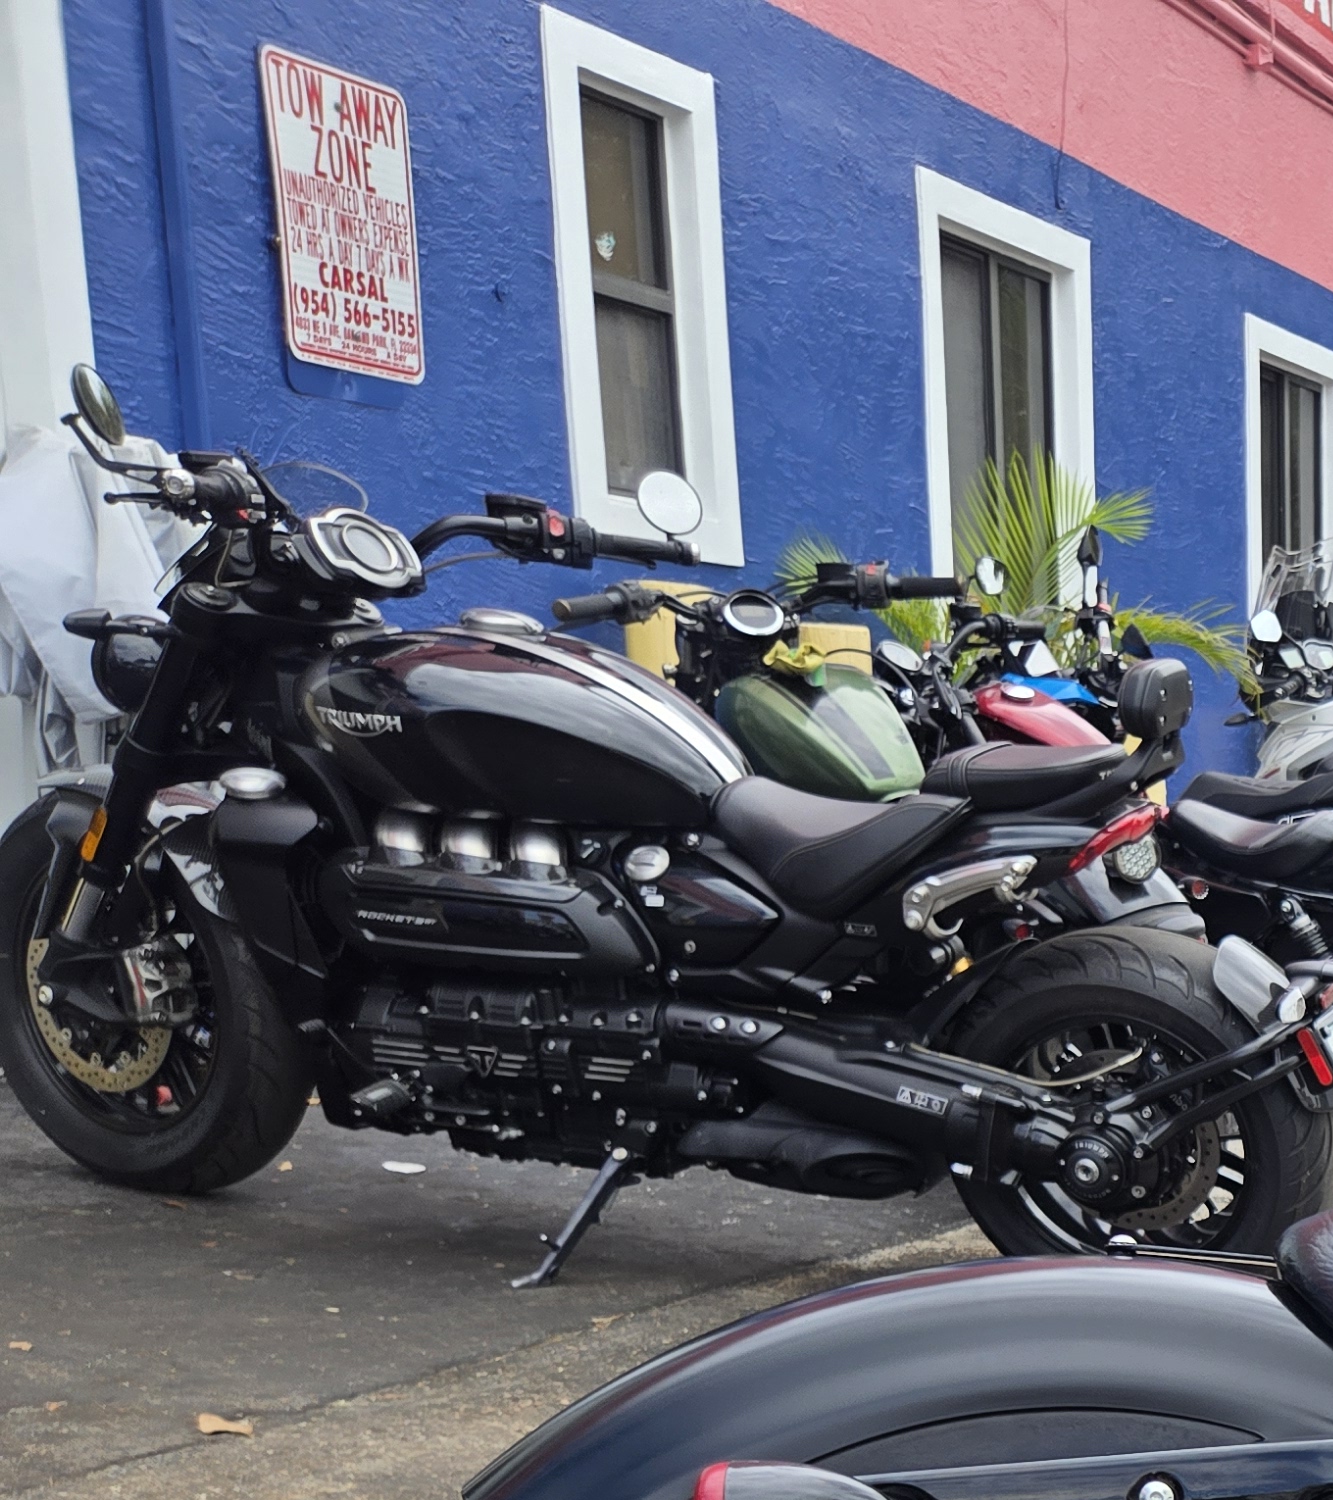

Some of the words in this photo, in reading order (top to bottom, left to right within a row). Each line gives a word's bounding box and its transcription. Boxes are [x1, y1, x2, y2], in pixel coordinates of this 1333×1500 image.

[271, 59, 325, 126] TOW
[340, 83, 397, 149] AWAY
[311, 125, 376, 193] ZONE
[284, 168, 359, 215] UNAUTHORIZED
[363, 193, 408, 230] VEHICLES
[286, 197, 317, 231] TOWED
[322, 208, 331, 235] AT
[334, 210, 370, 246] OWNERS
[373, 222, 409, 257] EXPENSE
[291, 226, 302, 254] 24
[306, 231, 324, 261] HRS
[338, 239, 352, 268] DAY
[365, 247, 386, 278] DAYS
[294, 282, 336, 322] (954)
[344, 298, 415, 339] 566-5155
[319, 261, 389, 303] CARSAL
[315, 706, 402, 734] TRIUMPH
